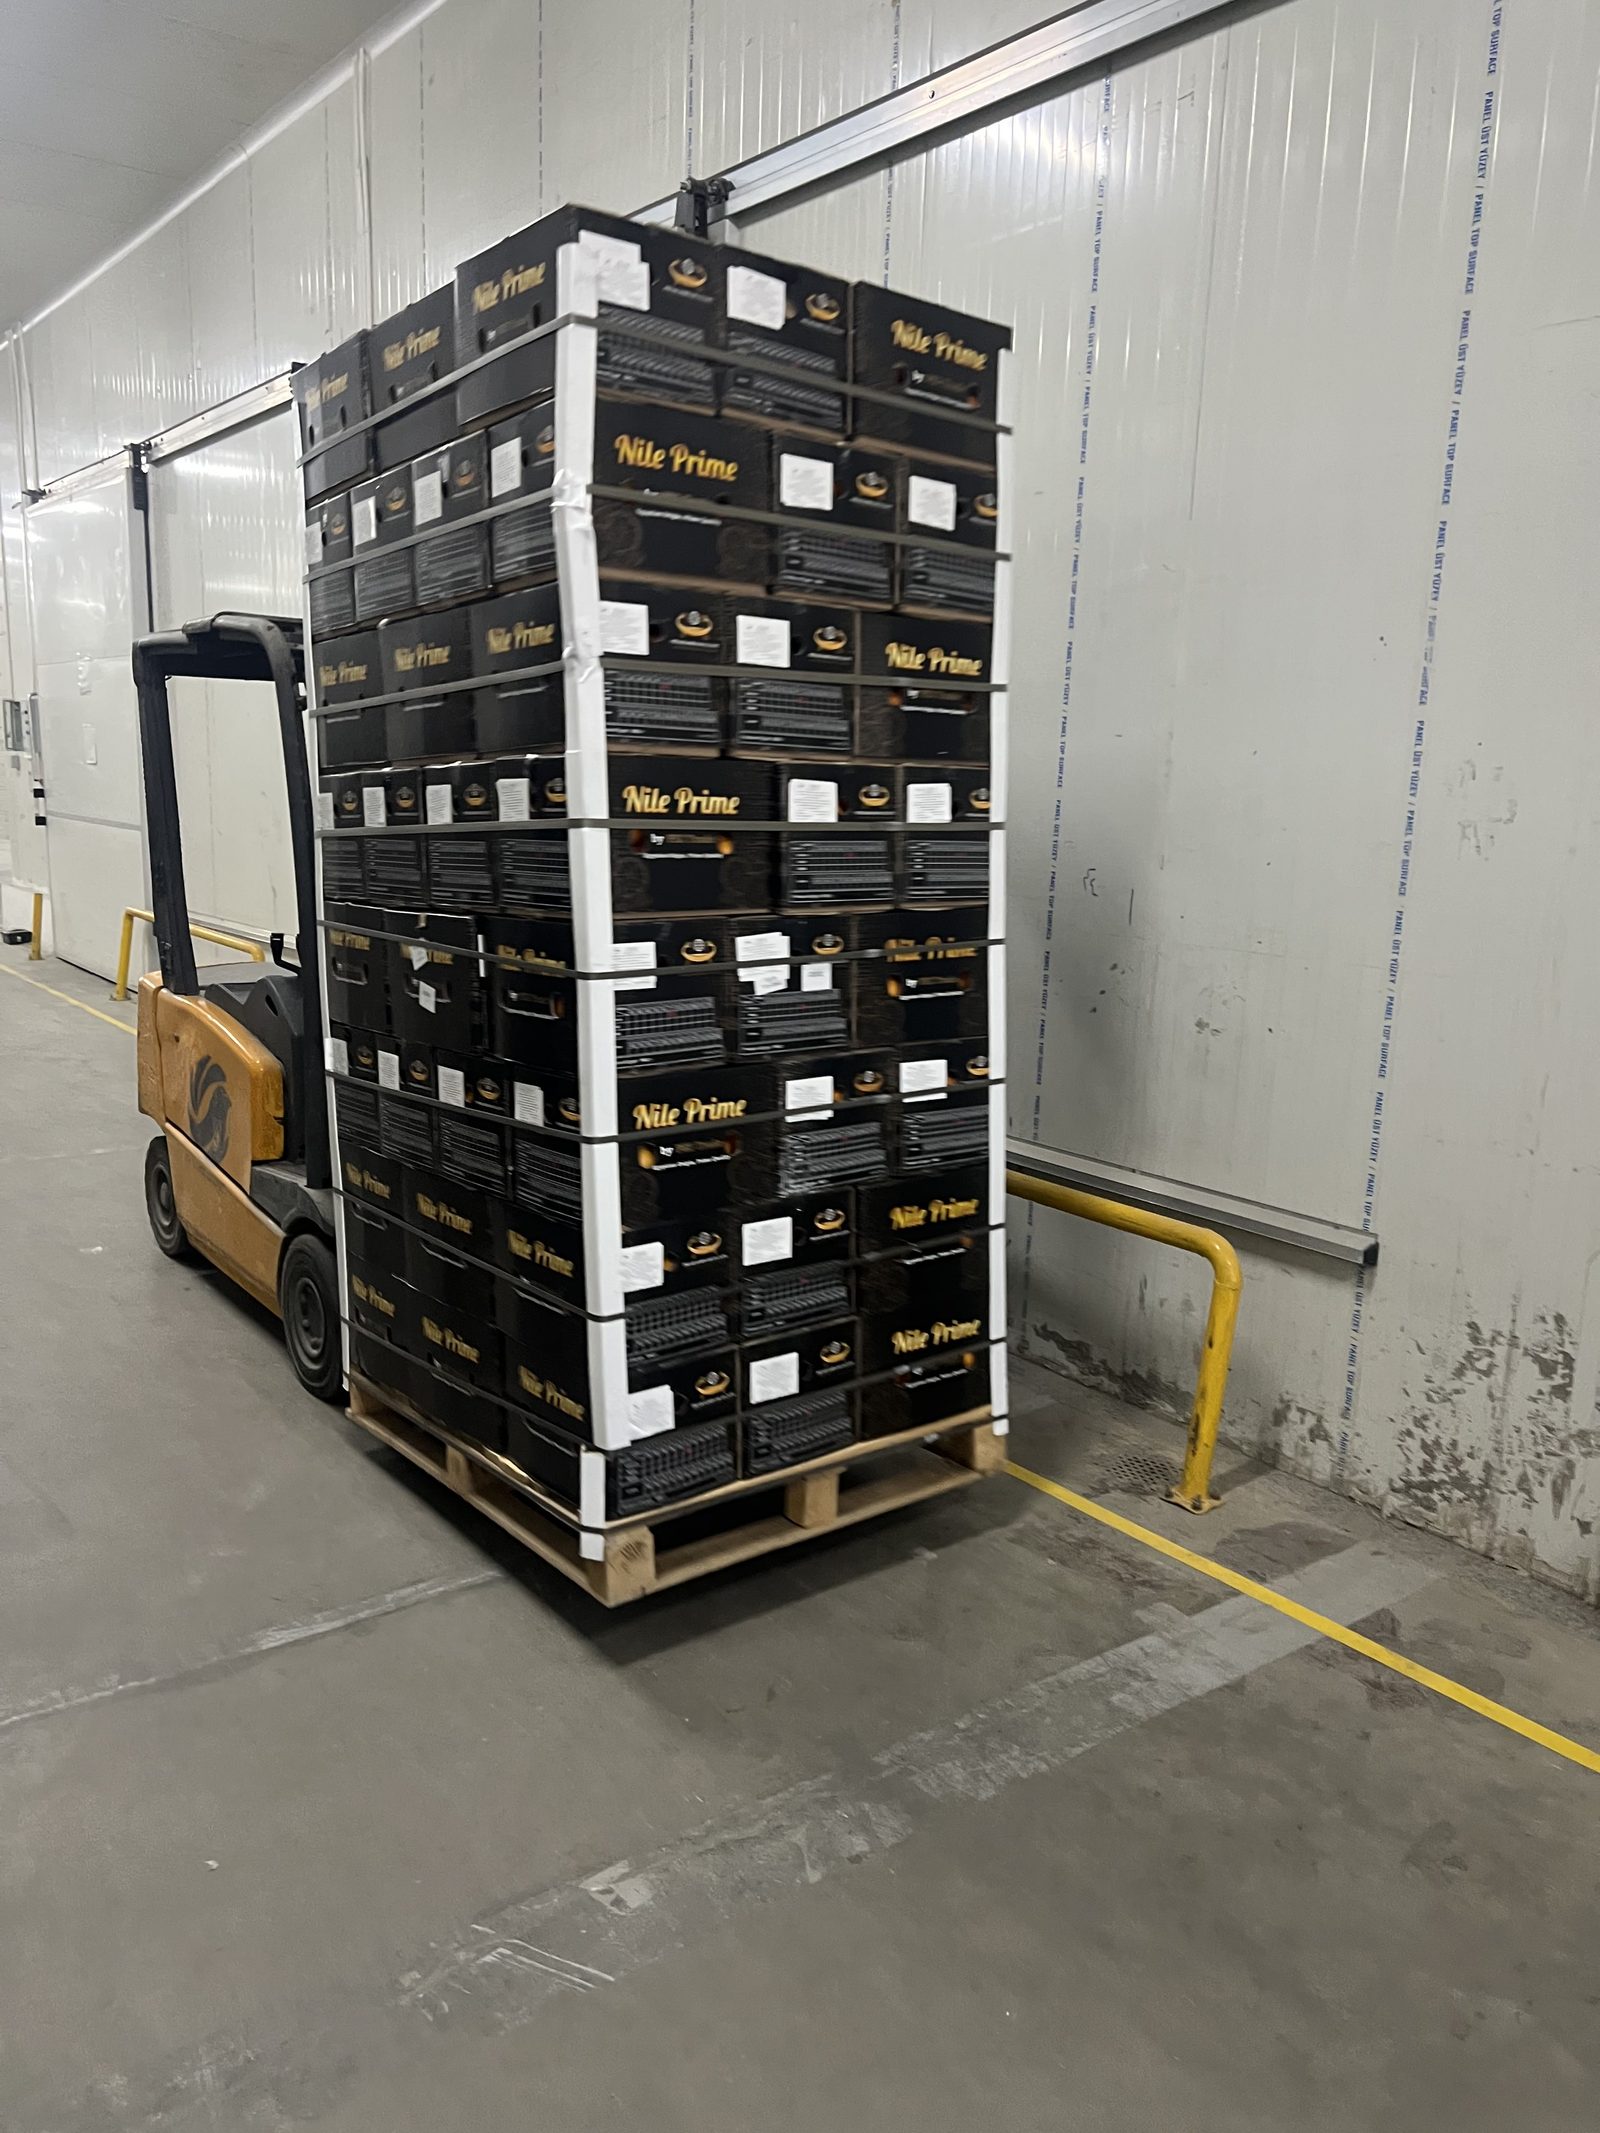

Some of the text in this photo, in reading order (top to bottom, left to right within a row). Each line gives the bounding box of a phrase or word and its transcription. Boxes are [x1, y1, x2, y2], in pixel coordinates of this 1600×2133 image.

[1491, 6, 1502, 26] TOP
[1487, 29, 1500, 76] SURFACE
[1482, 91, 1494, 123] PANEL
[1480, 126, 1492, 144] ÜST
[1477, 148, 1488, 178] YÜZEY
[1472, 193, 1484, 225] PANEL
[1469, 228, 1480, 246] TOP
[1464, 250, 1478, 293] SURFACE
[1459, 310, 1470, 340] PANEL
[891, 319, 989, 370] Nile Prime
[1457, 343, 1469, 361] ÜST
[1453, 365, 1465, 394] YÜZEY
[1448, 409, 1460, 439] PANEL
[614, 435, 664, 469] Nile
[669, 444, 738, 482] Prime
[1446, 442, 1457, 460] TOP
[1441, 463, 1454, 504] SURFACE
[1436, 521, 1448, 548] PANEL
[1433, 552, 1444, 570] ÜST
[885, 642, 982, 677] Nile Prime
[1414, 720, 1425, 745] PANEL
[1412, 750, 1423, 766] ÜST
[1408, 770, 1420, 797] YÜZEY
[622, 785, 741, 816] Nile Prime
[1405, 810, 1415, 836] PANEL
[1398, 859, 1410, 896] SURFACE
[1394, 910, 1404, 934] PANEL
[1391, 939, 1401, 954] ÜST
[1388, 958, 1399, 983] YÜZEY
[1384, 995, 1395, 1020] PANEL
[1382, 1024, 1392, 1040] TOP
[1377, 1042, 1390, 1078] SURFACE
[632, 1097, 747, 1129] Nile Prime
[1374, 1092, 1384, 1115] PANEL
[1372, 1119, 1382, 1134] ÜST
[1366, 1173, 1375, 1196] PANEL
[890, 1198, 979, 1230] Nile Prime
[1364, 1201, 1372, 1216] TOP
[507, 1229, 574, 1277] Nile Prime
[891, 1318, 980, 1355] Nile Prime
[1348, 1344, 1357, 1367] PANEL
[1346, 1371, 1355, 1384] TOP
[518, 1365, 585, 1421] Nile Prime
